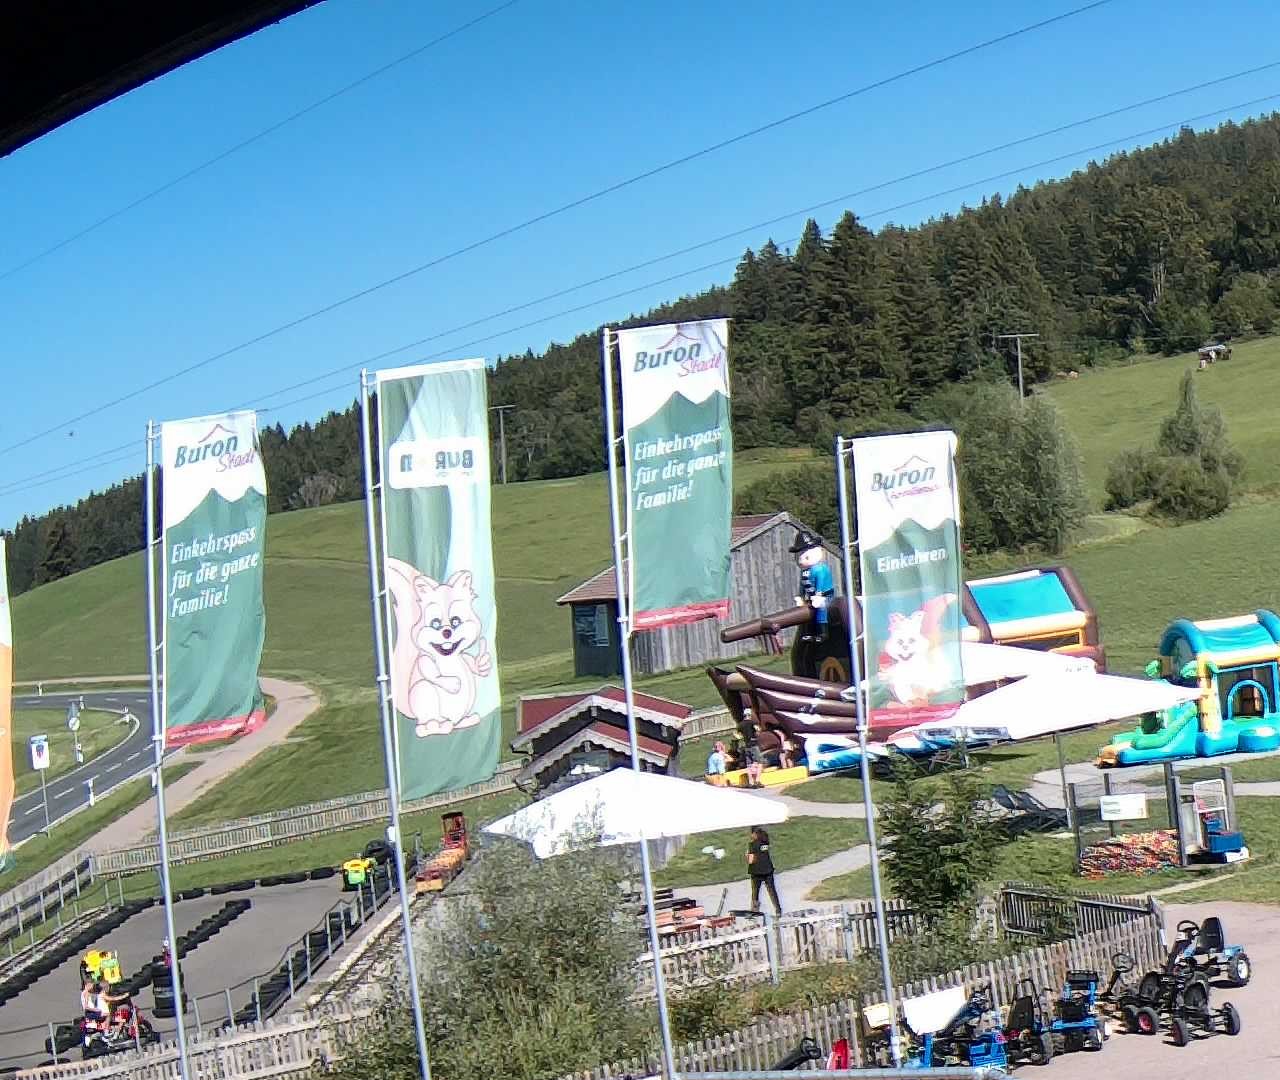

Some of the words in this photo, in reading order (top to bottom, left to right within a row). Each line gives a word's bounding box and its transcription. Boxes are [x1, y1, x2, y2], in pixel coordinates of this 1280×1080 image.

[633, 342, 701, 372] Buron
[174, 436, 238, 468] Buron
[661, 459, 687, 480] die
[871, 466, 935, 491] Buron
[169, 569, 192, 597] für
[195, 561, 218, 585] die
[170, 584, 229, 618] Familie!
